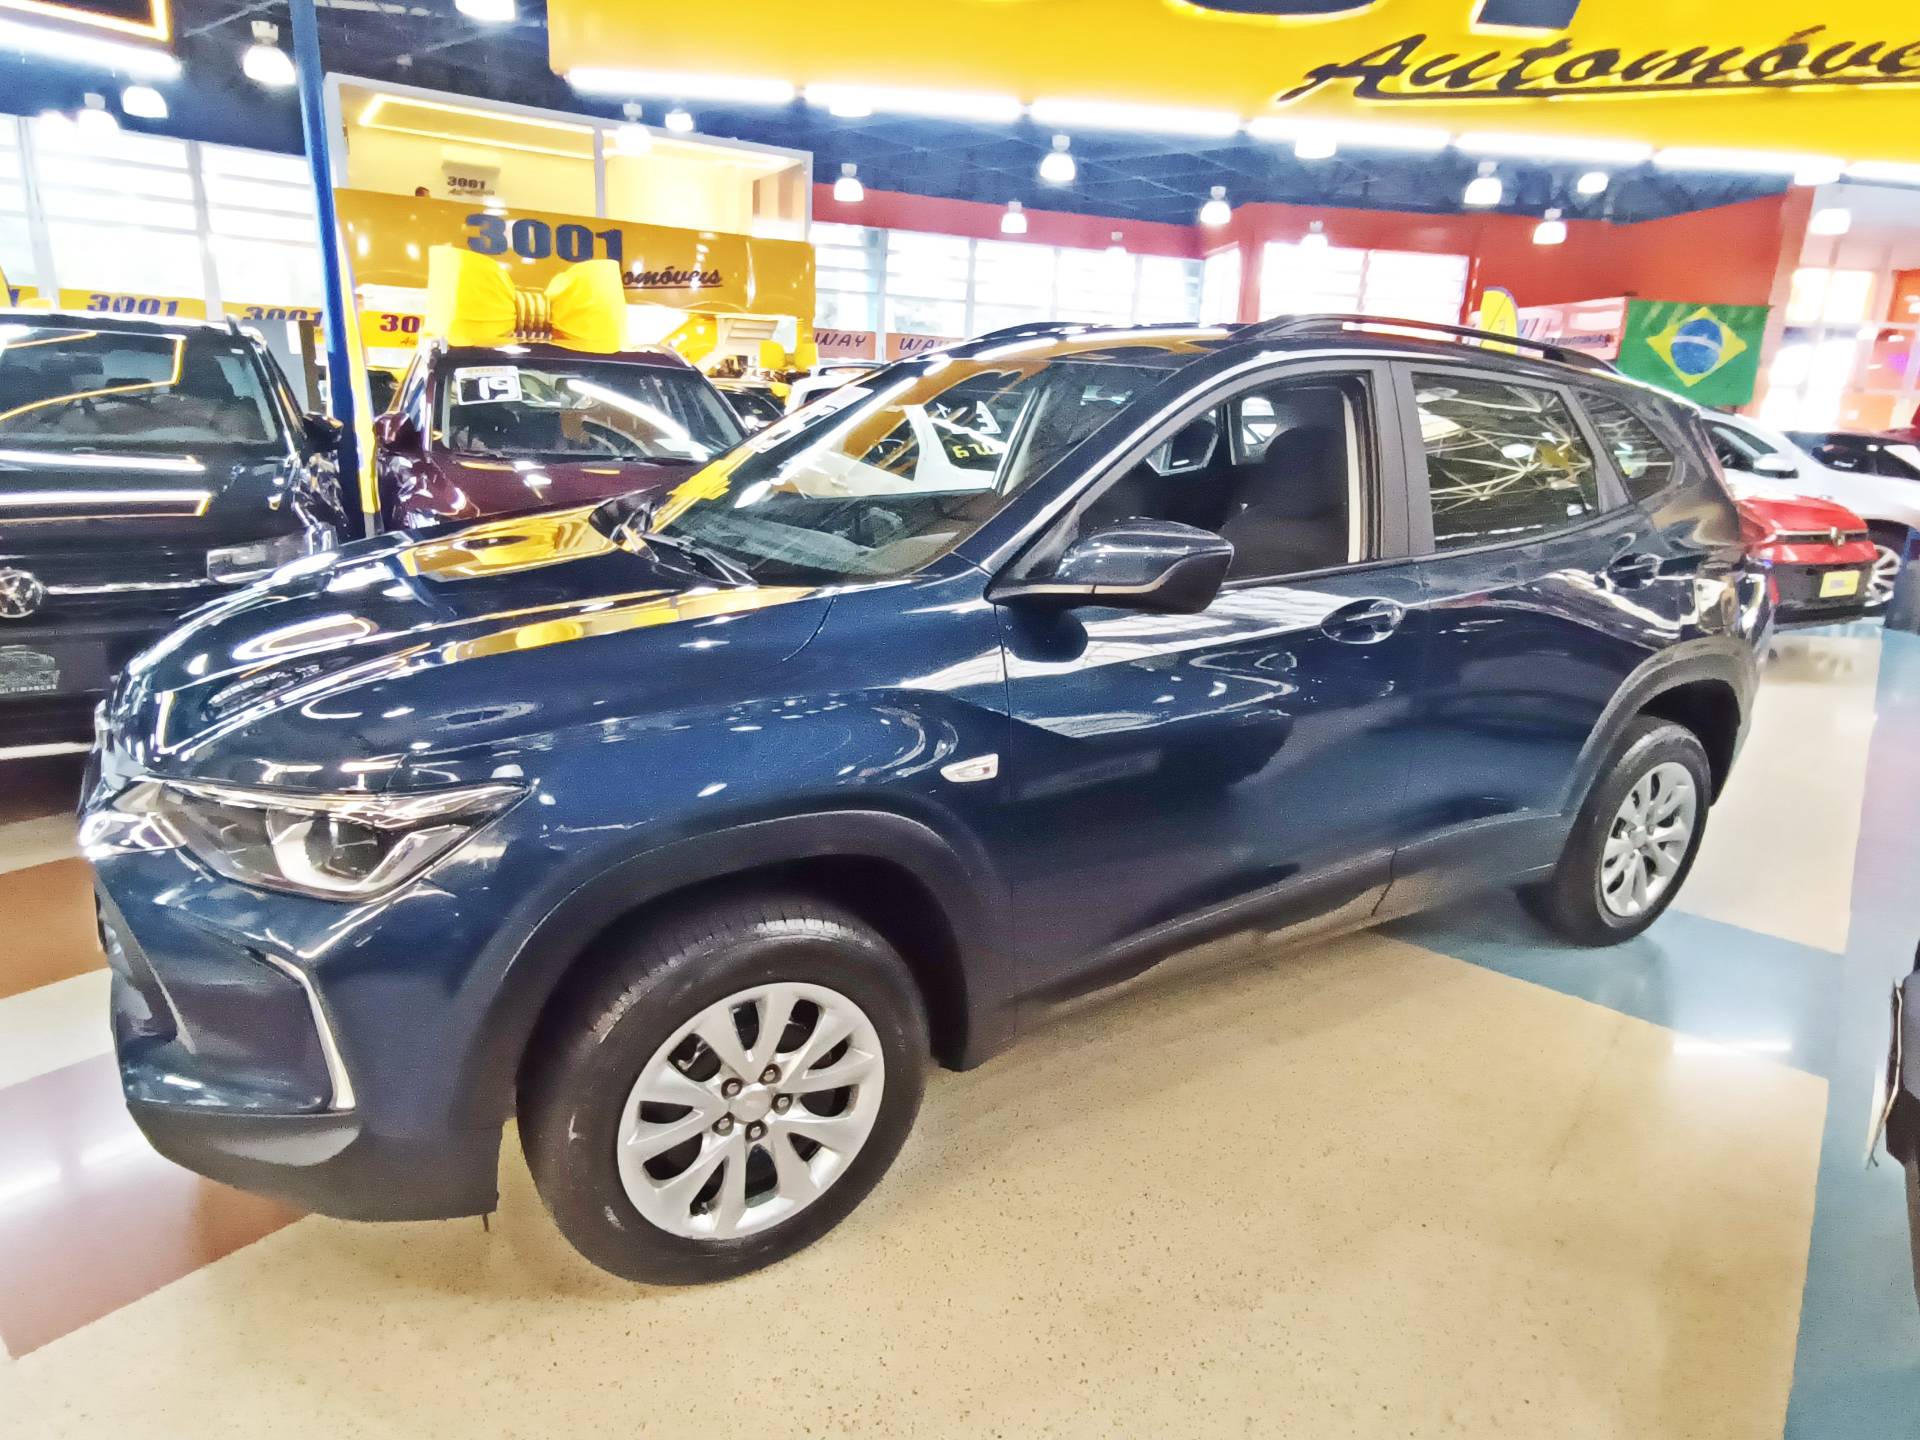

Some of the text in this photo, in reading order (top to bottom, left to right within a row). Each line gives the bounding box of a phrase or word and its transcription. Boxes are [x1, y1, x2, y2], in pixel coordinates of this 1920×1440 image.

[465, 213, 623, 265] 3001
[87, 294, 179, 316] 3001
[380, 314, 420, 333] 30
[899, 337, 950, 351] WA
